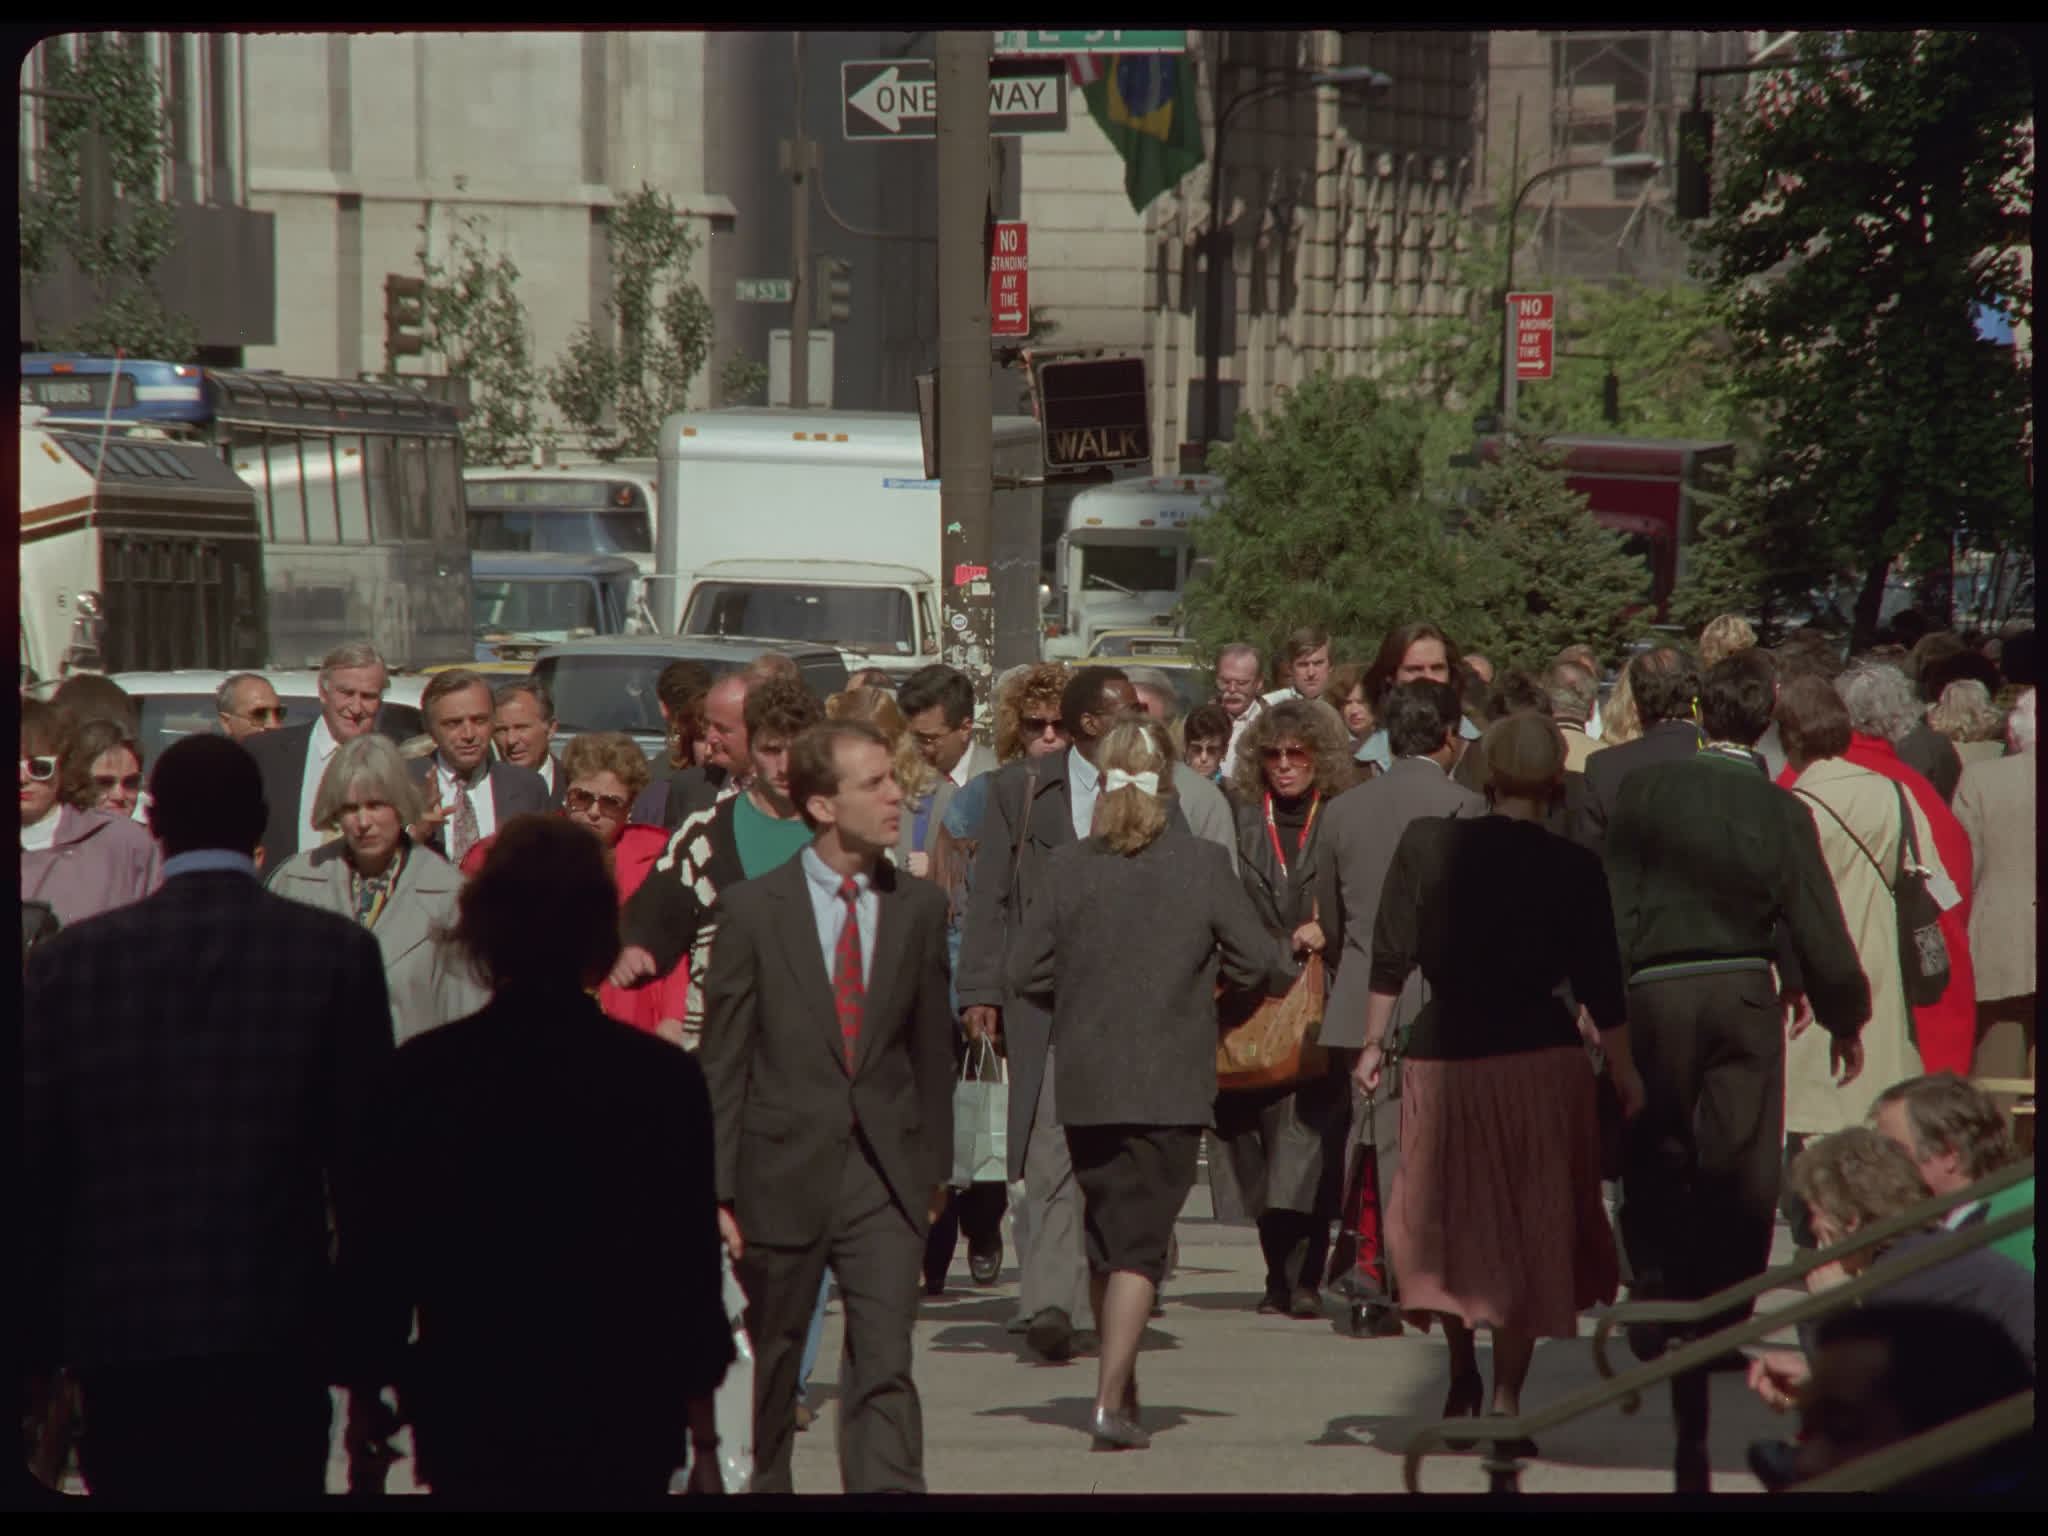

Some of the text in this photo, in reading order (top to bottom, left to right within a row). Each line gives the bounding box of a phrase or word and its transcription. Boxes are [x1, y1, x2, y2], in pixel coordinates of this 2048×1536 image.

[876, 85, 937, 113] ONE
[1000, 229, 1018, 252] NO
[992, 255, 1028, 271] STANDING
[1002, 275, 1017, 288] ANY
[1000, 292, 1018, 307] TIME
[1520, 298, 1543, 316] NO
[1519, 318, 1553, 331] ANDING
[1521, 332, 1540, 345] ANY
[1519, 345, 1541, 358] TIME
[1056, 427, 1140, 460] WALK
